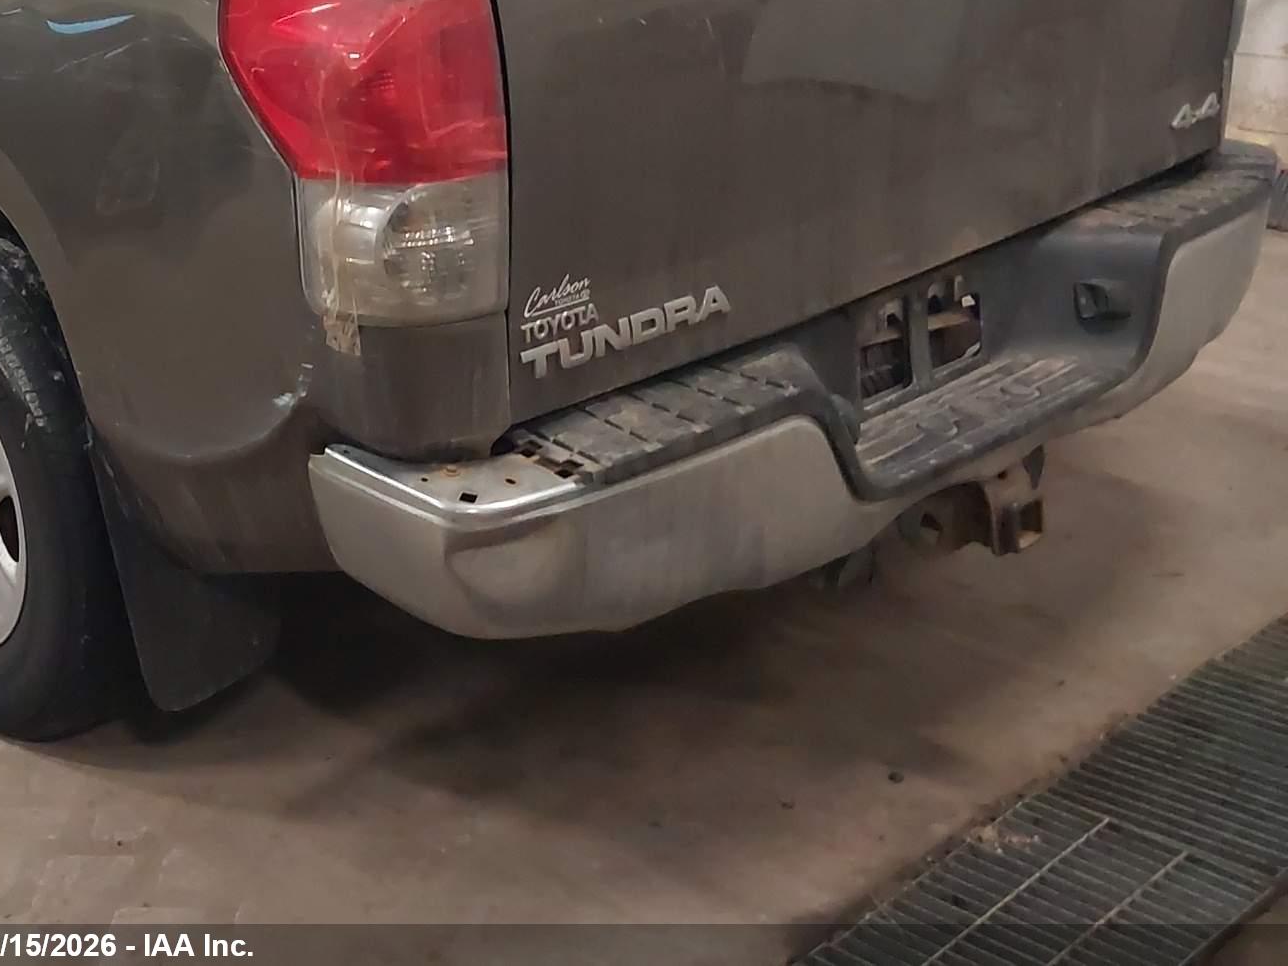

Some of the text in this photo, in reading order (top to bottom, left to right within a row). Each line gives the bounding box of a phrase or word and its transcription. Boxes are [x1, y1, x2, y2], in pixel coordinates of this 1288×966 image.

[524, 273, 591, 318] Carlson
[520, 303, 599, 343] TOYOTA
[520, 285, 731, 378] TUNDRA
